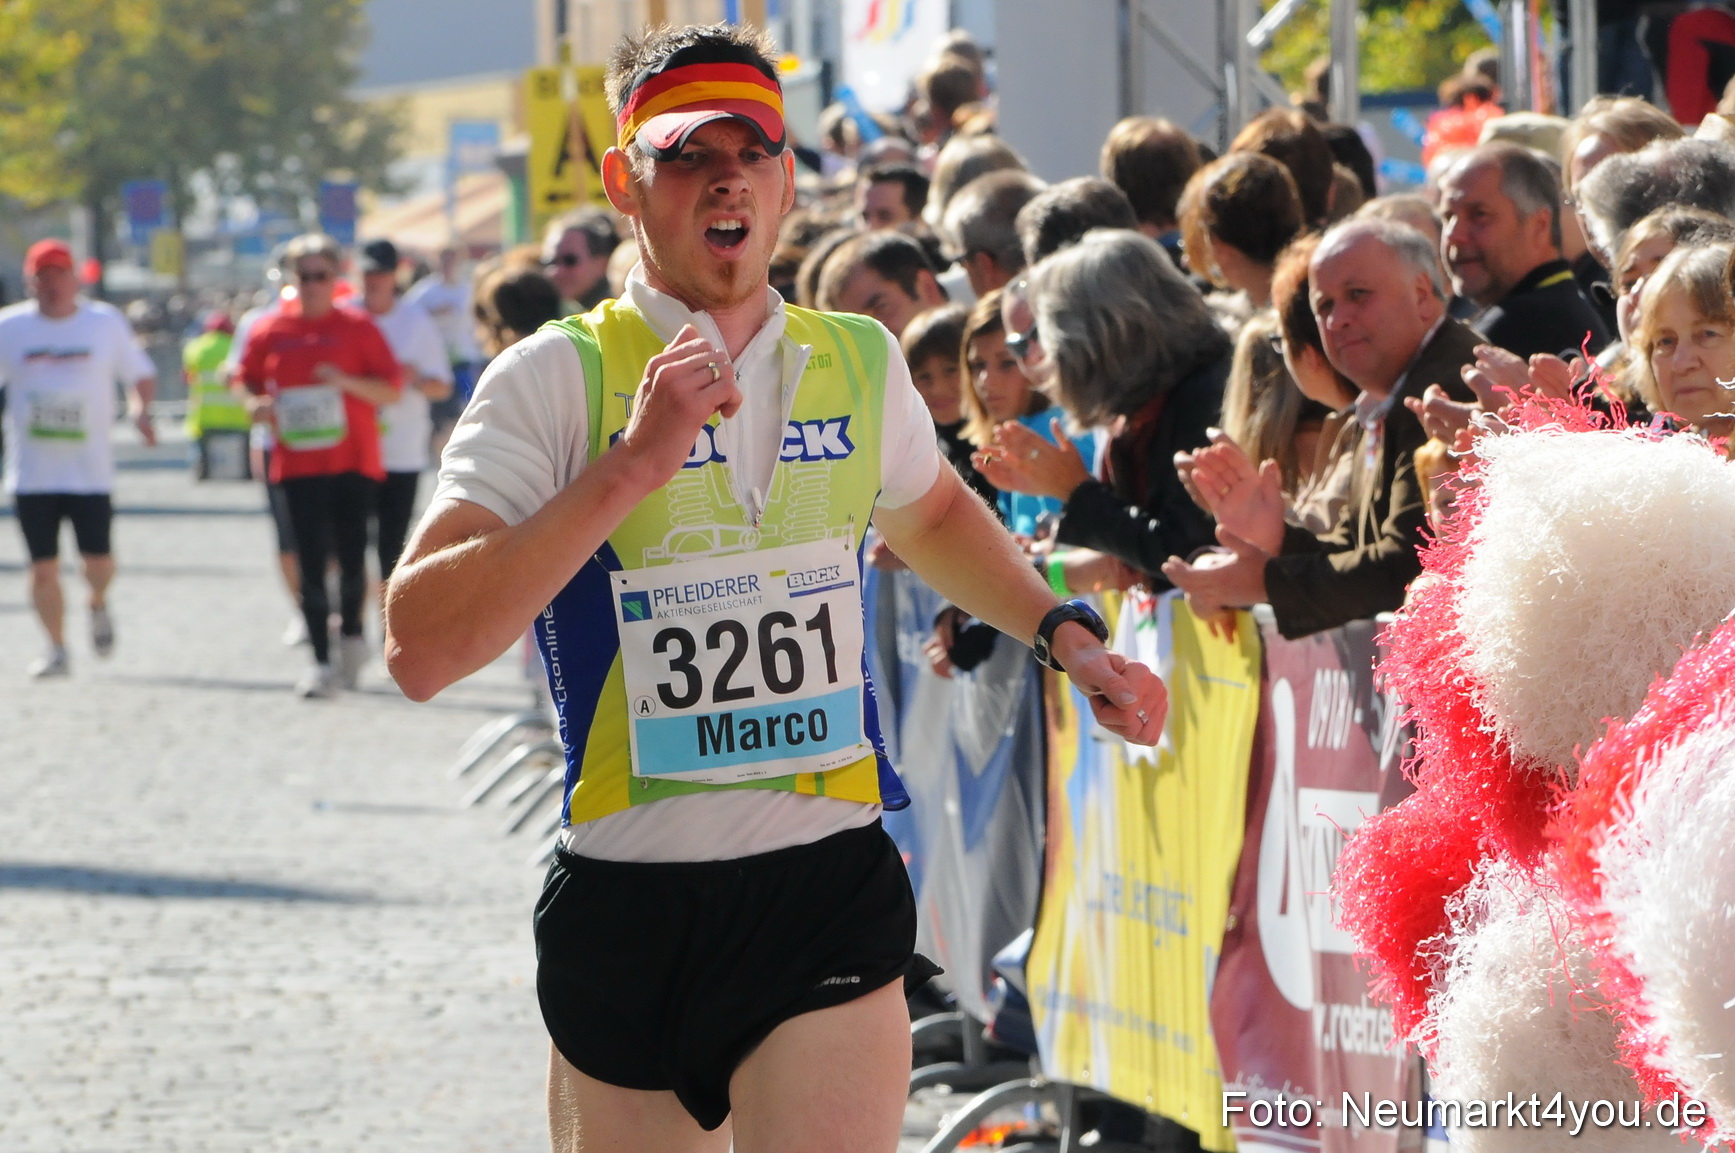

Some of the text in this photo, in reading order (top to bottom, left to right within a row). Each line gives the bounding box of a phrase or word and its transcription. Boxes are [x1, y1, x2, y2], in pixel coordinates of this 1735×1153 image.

[653, 573, 761, 608] PFLEIDERER
[787, 565, 841, 589] BOCK
[656, 595, 763, 619] AKTIENGESELLSCHAFT
[652, 602, 838, 711] 3261
[696, 708, 828, 757] Marco
